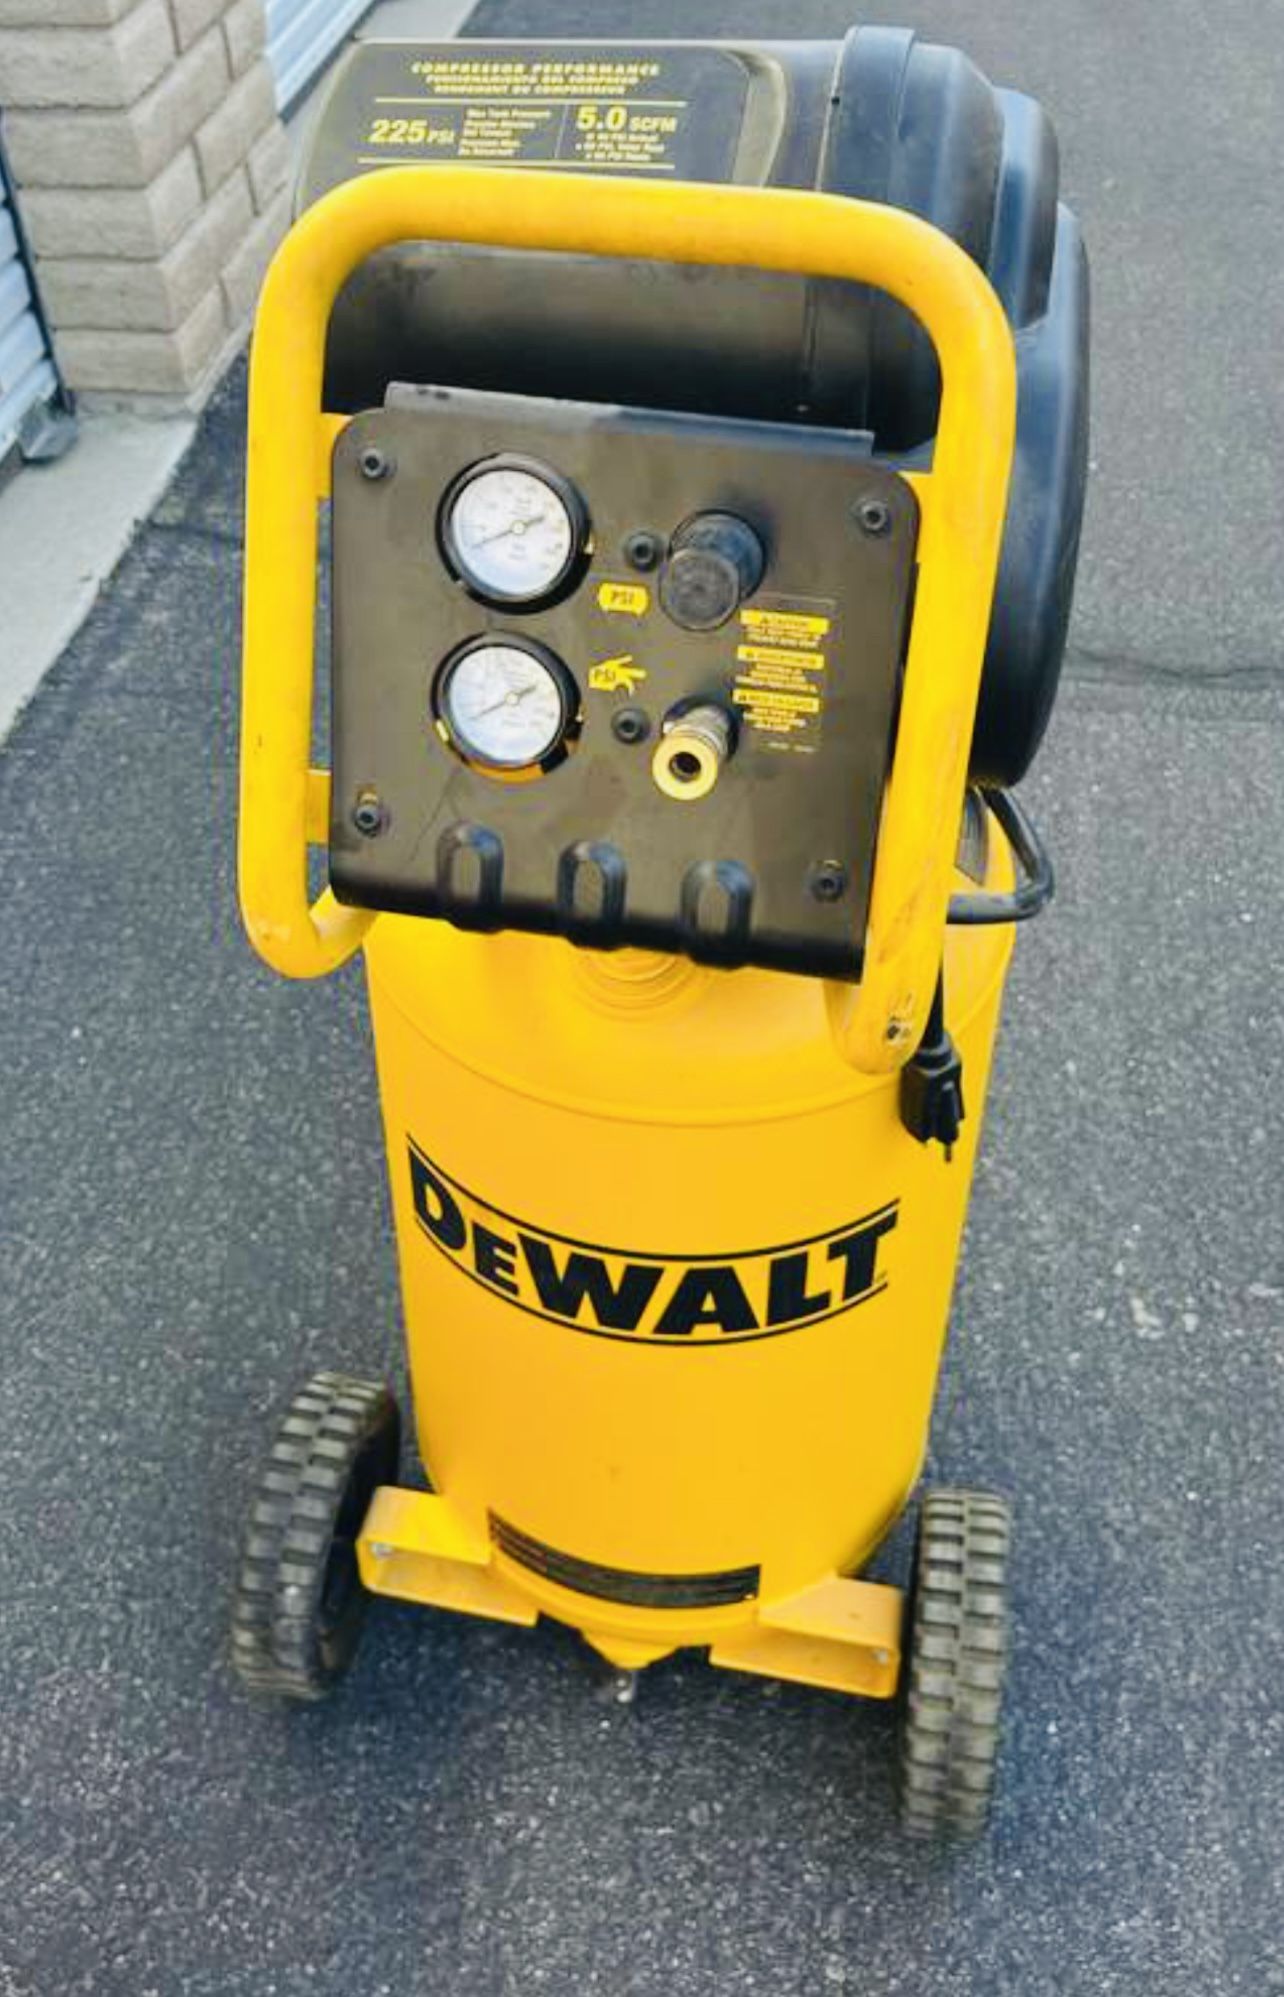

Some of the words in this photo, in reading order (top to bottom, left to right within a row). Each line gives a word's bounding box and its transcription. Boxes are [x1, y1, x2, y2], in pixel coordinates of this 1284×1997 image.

[411, 62, 526, 75] COMPRESSOR
[532, 62, 660, 76] PERFORMANCE
[576, 104, 628, 131] 5.0
[629, 116, 678, 132] SCFM
[369, 118, 428, 144] 225
[426, 129, 456, 145] PSI
[610, 590, 635, 606] PSI
[593, 668, 617, 684] PSI
